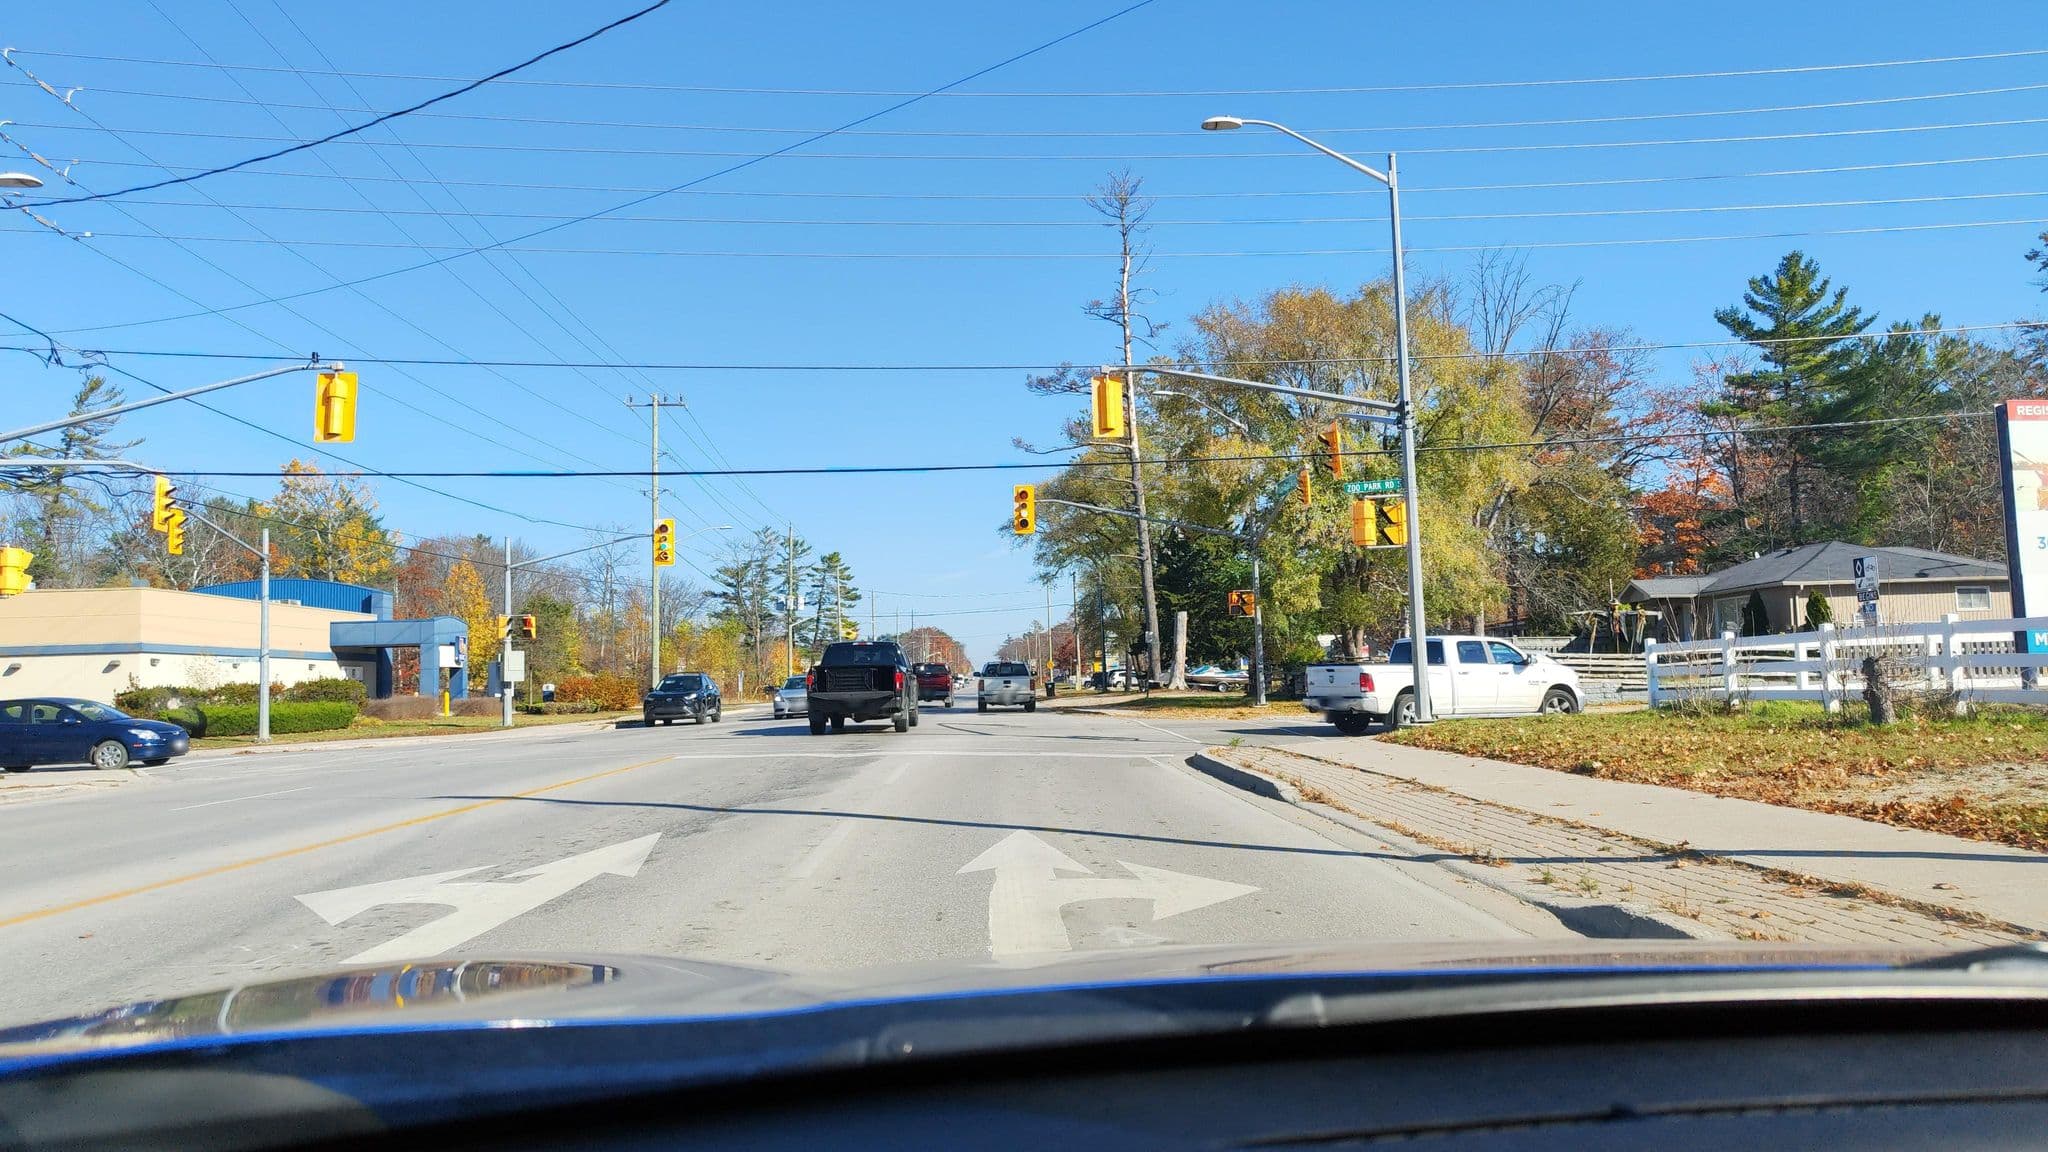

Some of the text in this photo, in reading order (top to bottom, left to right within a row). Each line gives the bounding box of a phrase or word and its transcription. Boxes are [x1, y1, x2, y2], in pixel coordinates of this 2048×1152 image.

[1347, 484, 1361, 493] ZOO
[1364, 482, 1382, 491] PARK
[1385, 481, 1395, 489] RD
[2037, 536, 2048, 550] 3
